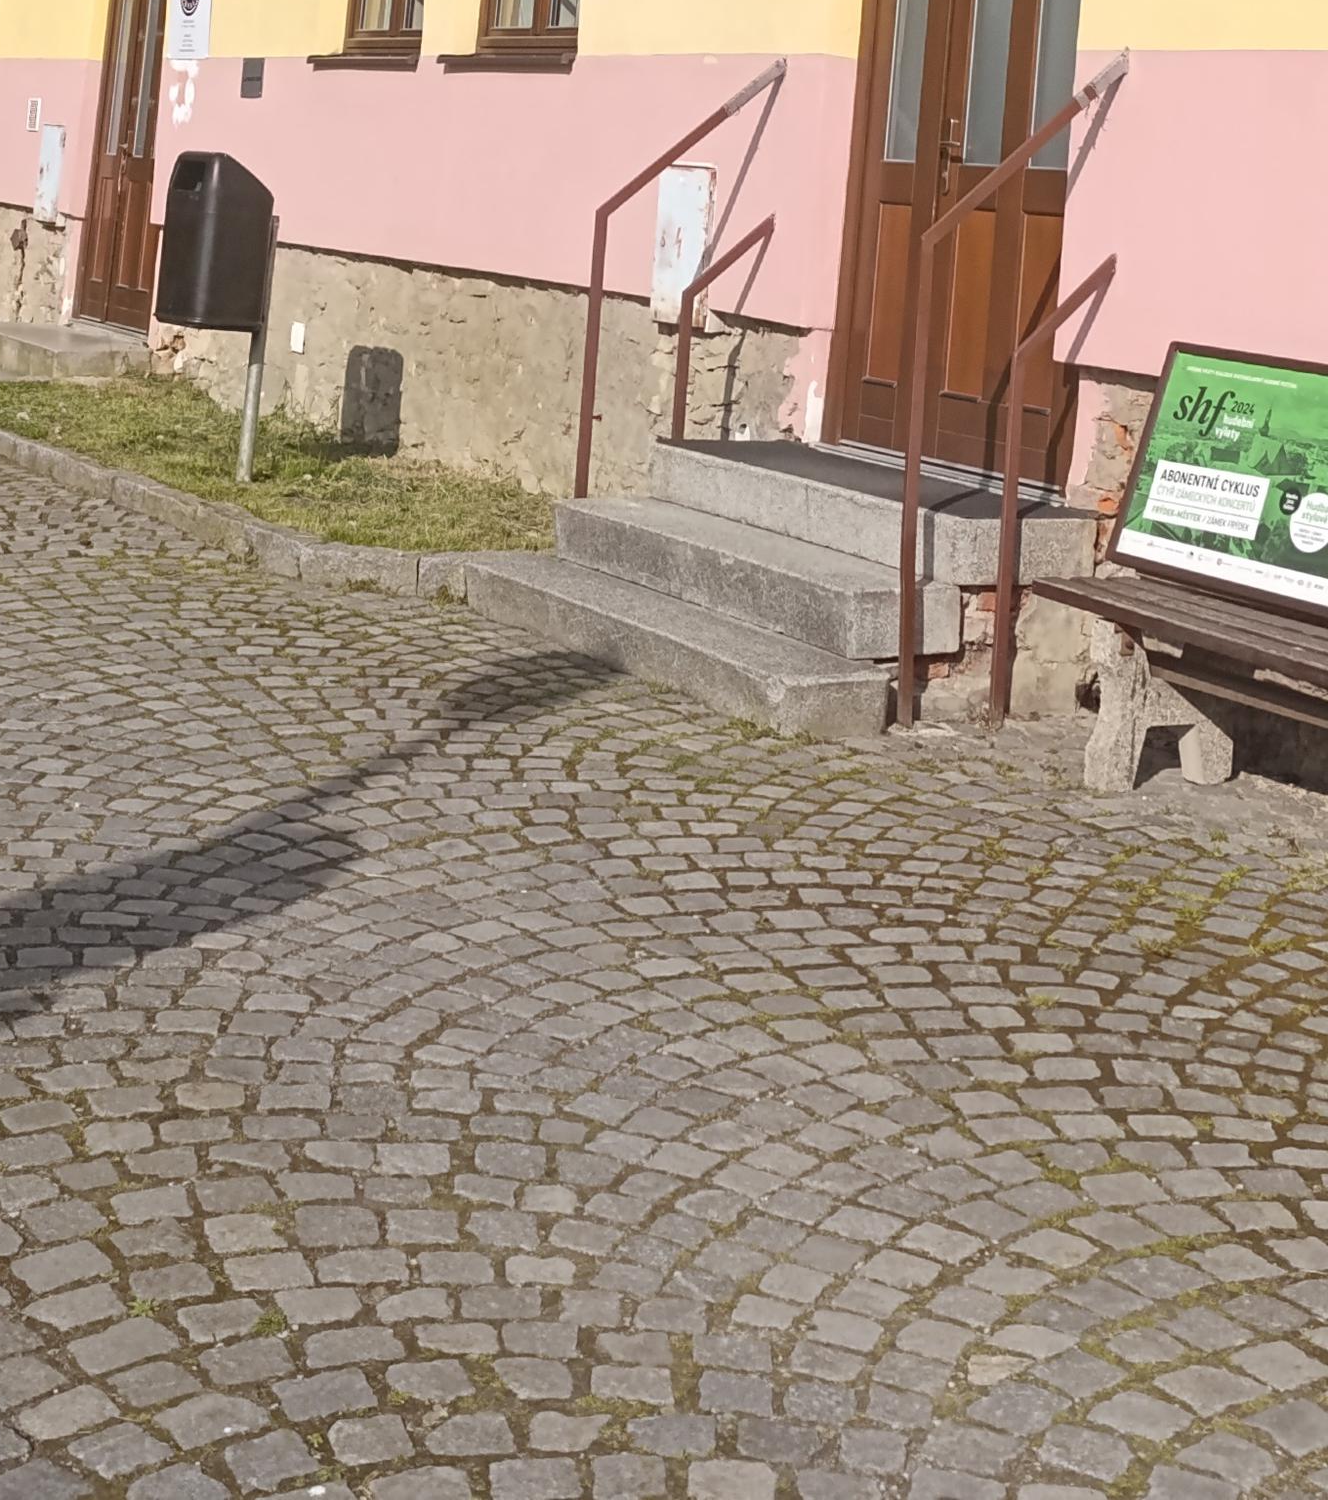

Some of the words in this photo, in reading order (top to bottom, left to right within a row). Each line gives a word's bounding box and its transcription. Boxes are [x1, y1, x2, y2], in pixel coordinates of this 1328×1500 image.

[1172, 386, 1236, 437] shf
[1230, 400, 1256, 416] 2024
[1160, 468, 1220, 491] ABONENTNÍ
[1220, 479, 1260, 498] CYKLUS
